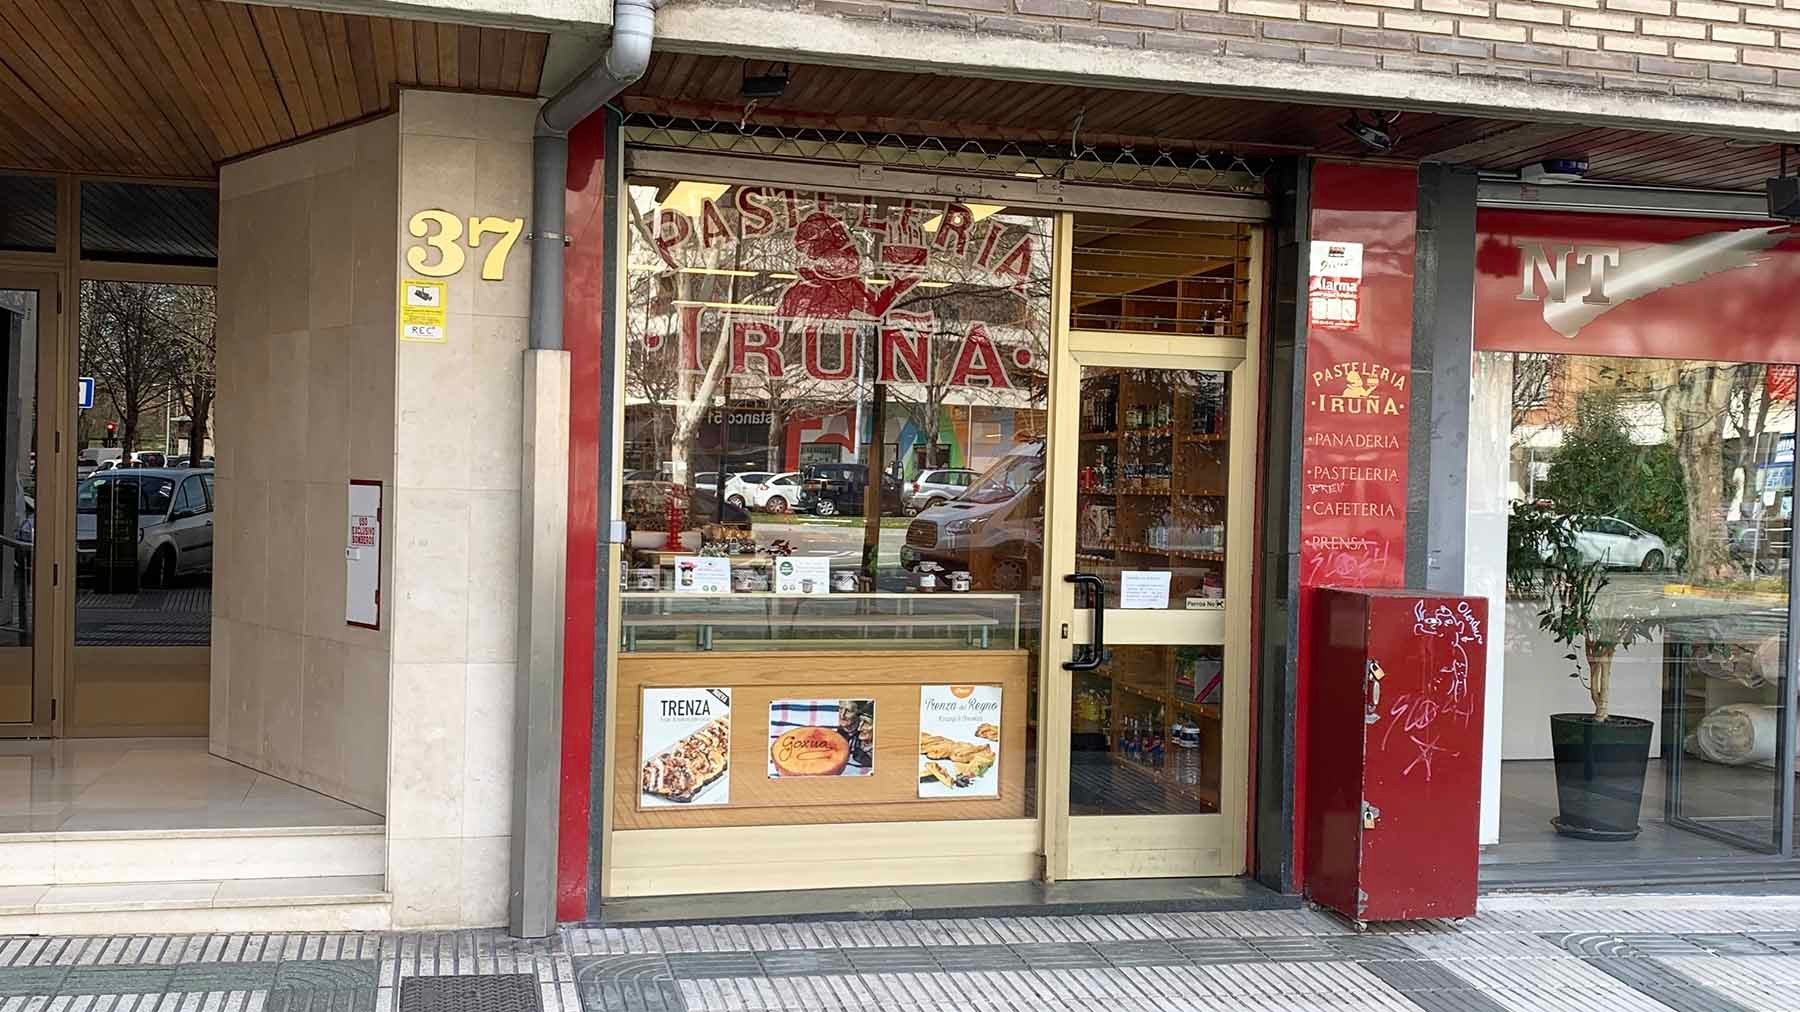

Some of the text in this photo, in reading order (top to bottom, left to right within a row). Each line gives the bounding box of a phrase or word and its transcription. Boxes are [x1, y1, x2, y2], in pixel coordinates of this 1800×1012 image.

[407, 209, 524, 281] 37
[1513, 240, 1620, 304] NT
[678, 303, 1010, 390] IRUÑA
[1312, 362, 1406, 391] PASTELERIA
[1319, 394, 1400, 415] IRUÑA
[1314, 432, 1400, 449] PANADERIA
[1314, 466, 1399, 481] PASTELERIA
[1312, 501, 1395, 517] CAFETERIA
[1311, 536, 1368, 550] PRENSA
[660, 699, 711, 716] TRENZA
